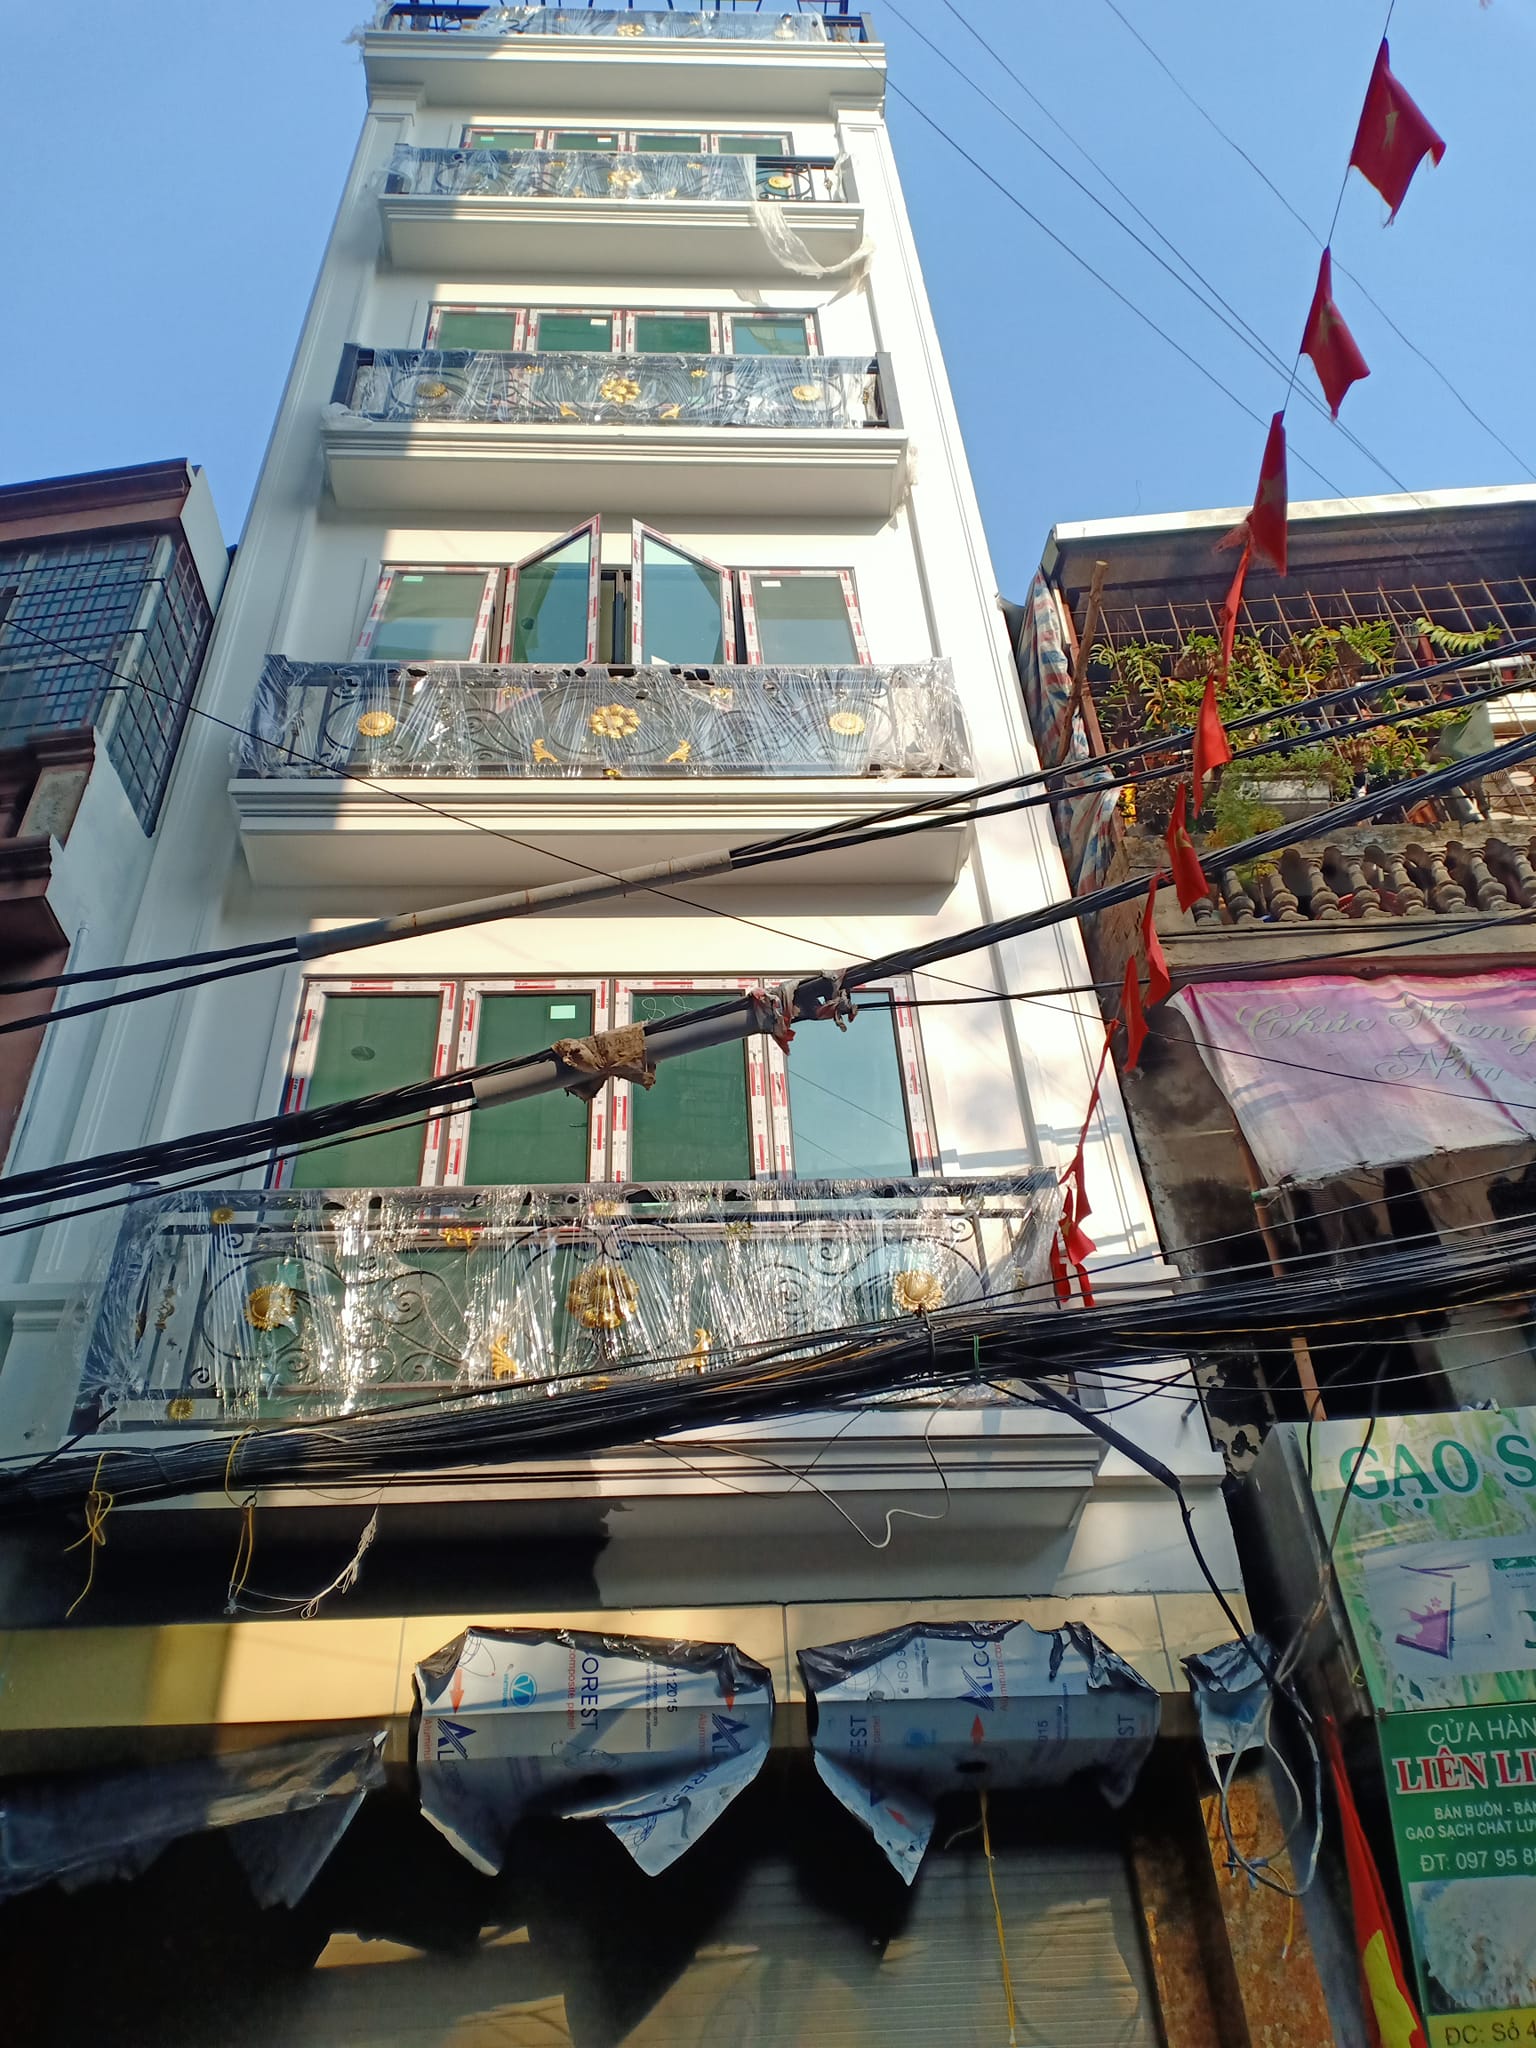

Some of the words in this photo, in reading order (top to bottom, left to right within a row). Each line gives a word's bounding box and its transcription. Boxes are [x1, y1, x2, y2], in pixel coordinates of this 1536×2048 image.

[1340, 1439, 1479, 1509] GẠO
[896, 1660, 909, 1682] ISO
[580, 1656, 600, 1731] OREST
[1427, 1718, 1484, 1745] CỬA
[1392, 1745, 1488, 1794] LIÊN
[1490, 1748, 1536, 1787] LI
[1465, 1800, 1503, 1818] BUÔN
[1405, 1826, 1435, 1842] GẠO
[1437, 1823, 1474, 1840] SẠCH
[1456, 1850, 1488, 1870] 097
[1494, 1849, 1518, 1867] 95
[1523, 1848, 1536, 1865] 8
